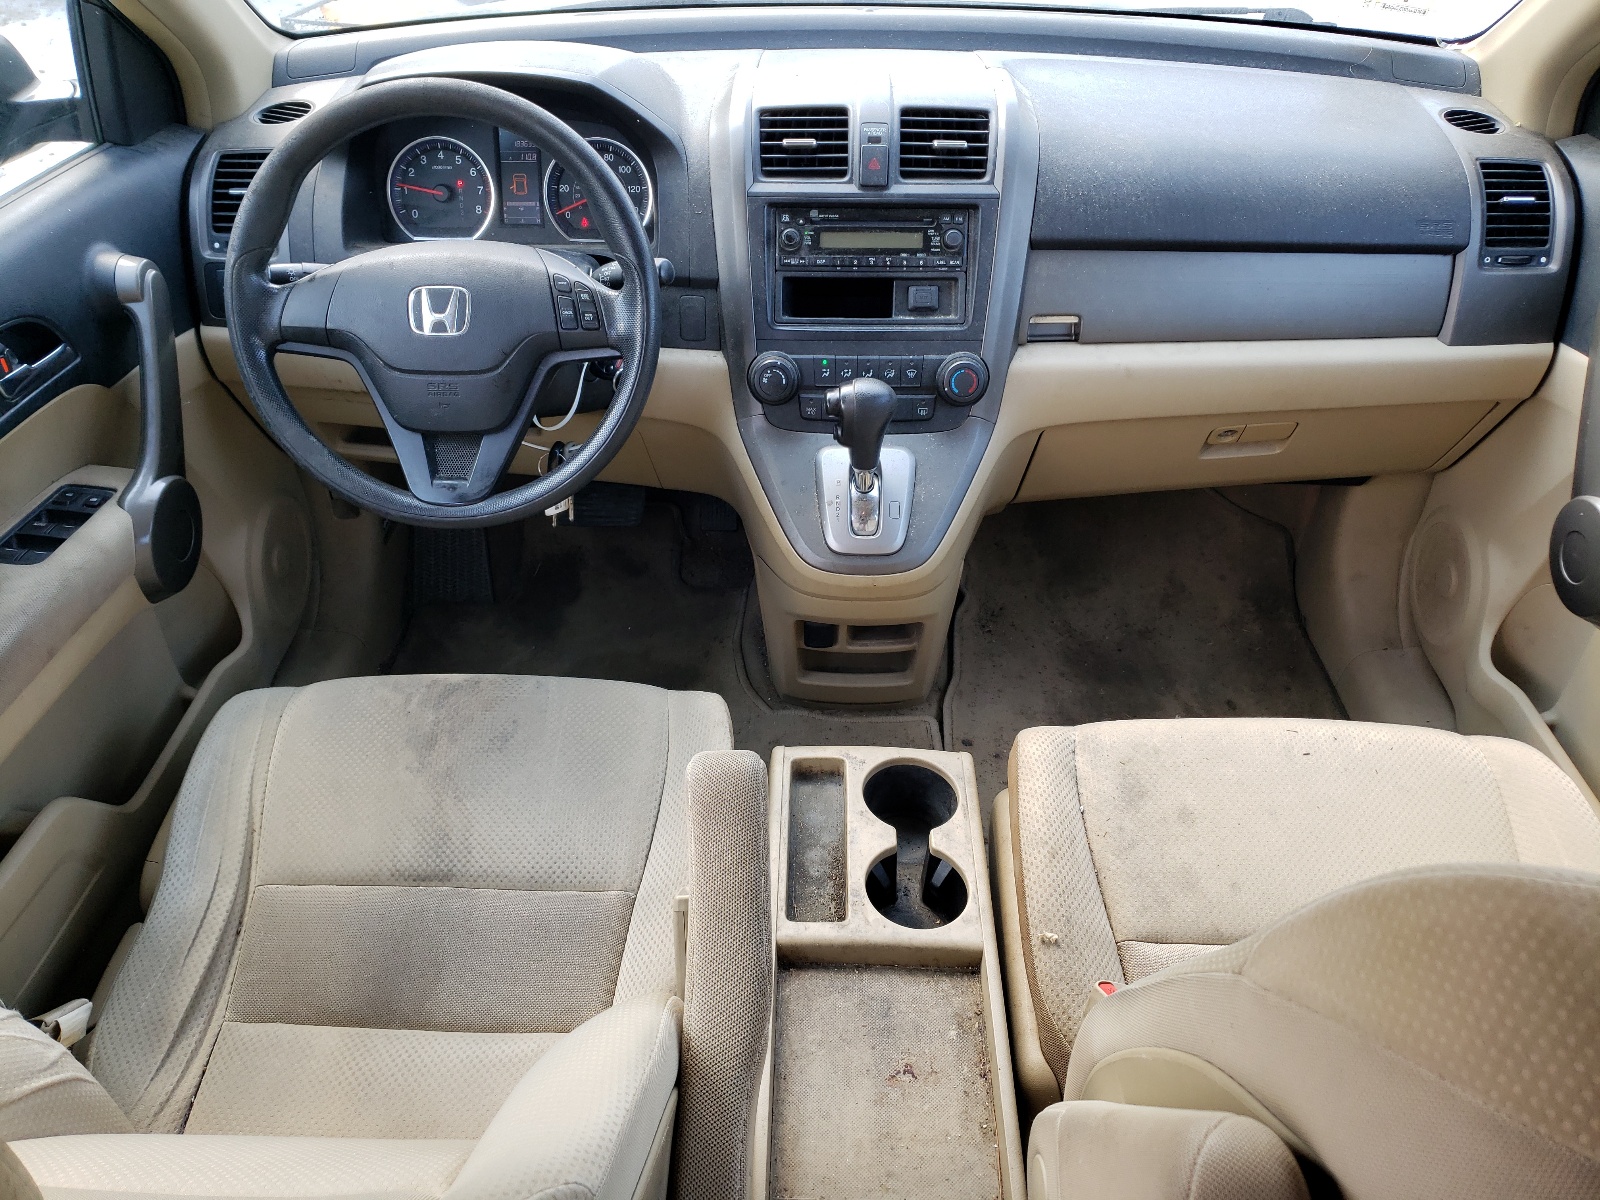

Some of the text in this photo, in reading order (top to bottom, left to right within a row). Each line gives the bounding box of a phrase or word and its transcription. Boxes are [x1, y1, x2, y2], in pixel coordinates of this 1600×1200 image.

[420, 155, 427, 164] 3
[437, 151, 444, 159] 4
[455, 156, 462, 164] 5
[408, 168, 415, 176] 2
[469, 168, 476, 176] 6
[477, 186, 484, 195] 7
[411, 209, 418, 218] 0
[475, 205, 482, 214] 8
[426, 382, 460, 391] SRS
